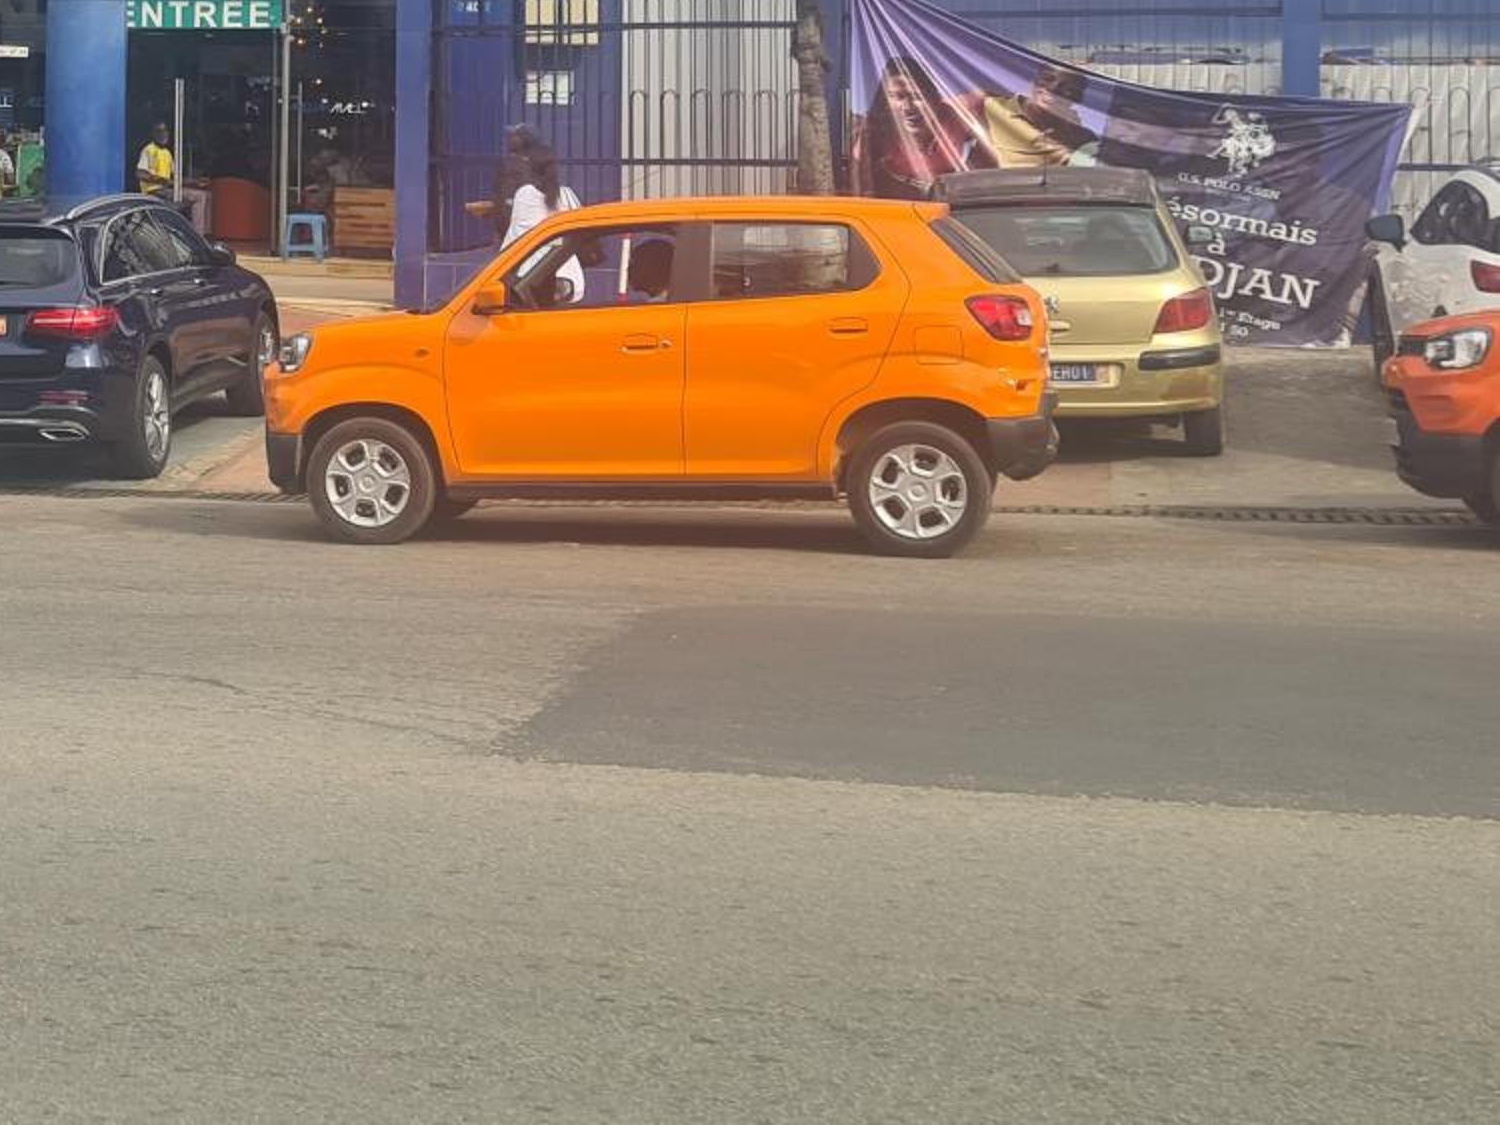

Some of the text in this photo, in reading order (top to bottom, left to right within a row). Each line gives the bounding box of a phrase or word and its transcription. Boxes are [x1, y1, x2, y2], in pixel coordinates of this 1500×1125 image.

[1203, 177, 1241, 192] POLO
[1167, 195, 1318, 246] ésormais
[1206, 231, 1227, 256] à
[1189, 254, 1321, 309] DJAN
